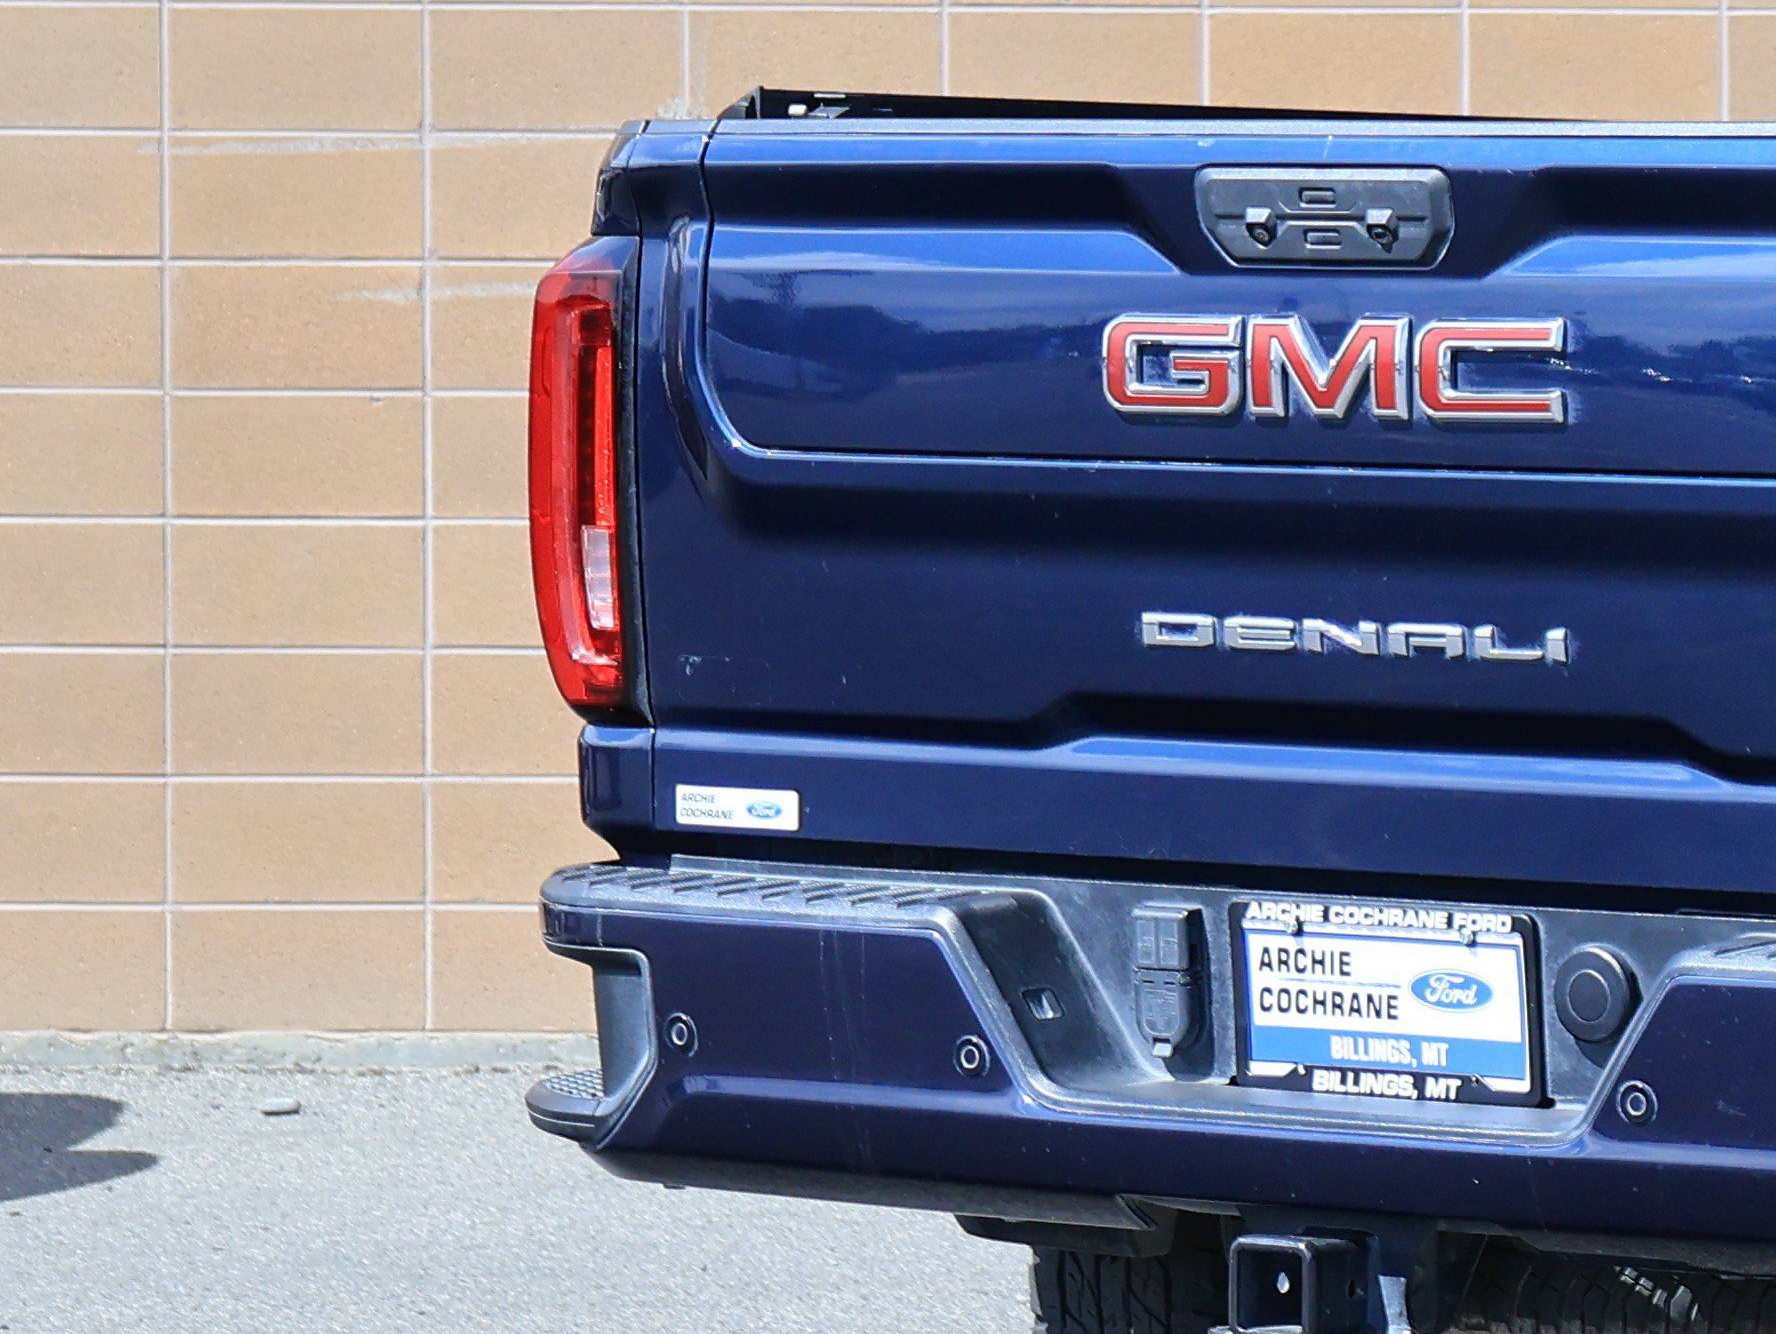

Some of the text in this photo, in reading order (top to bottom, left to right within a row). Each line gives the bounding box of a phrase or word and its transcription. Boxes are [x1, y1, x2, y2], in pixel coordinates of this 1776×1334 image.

[1101, 313, 1567, 424] GMC
[1140, 610, 1570, 664] DENALI
[679, 807, 734, 820] COCHRANE
[680, 792, 716, 804] ARCHIE
[1246, 902, 1513, 934] ARCHIE COCHRANE FORD
[1258, 946, 1352, 977] ARCHIE
[1258, 987, 1399, 1020] COCHRANE
[1425, 973, 1478, 1006] Ford
[1330, 1035, 1449, 1068] BILLINGS, MT
[1312, 1069, 1462, 1100] BILLINGS, MT
